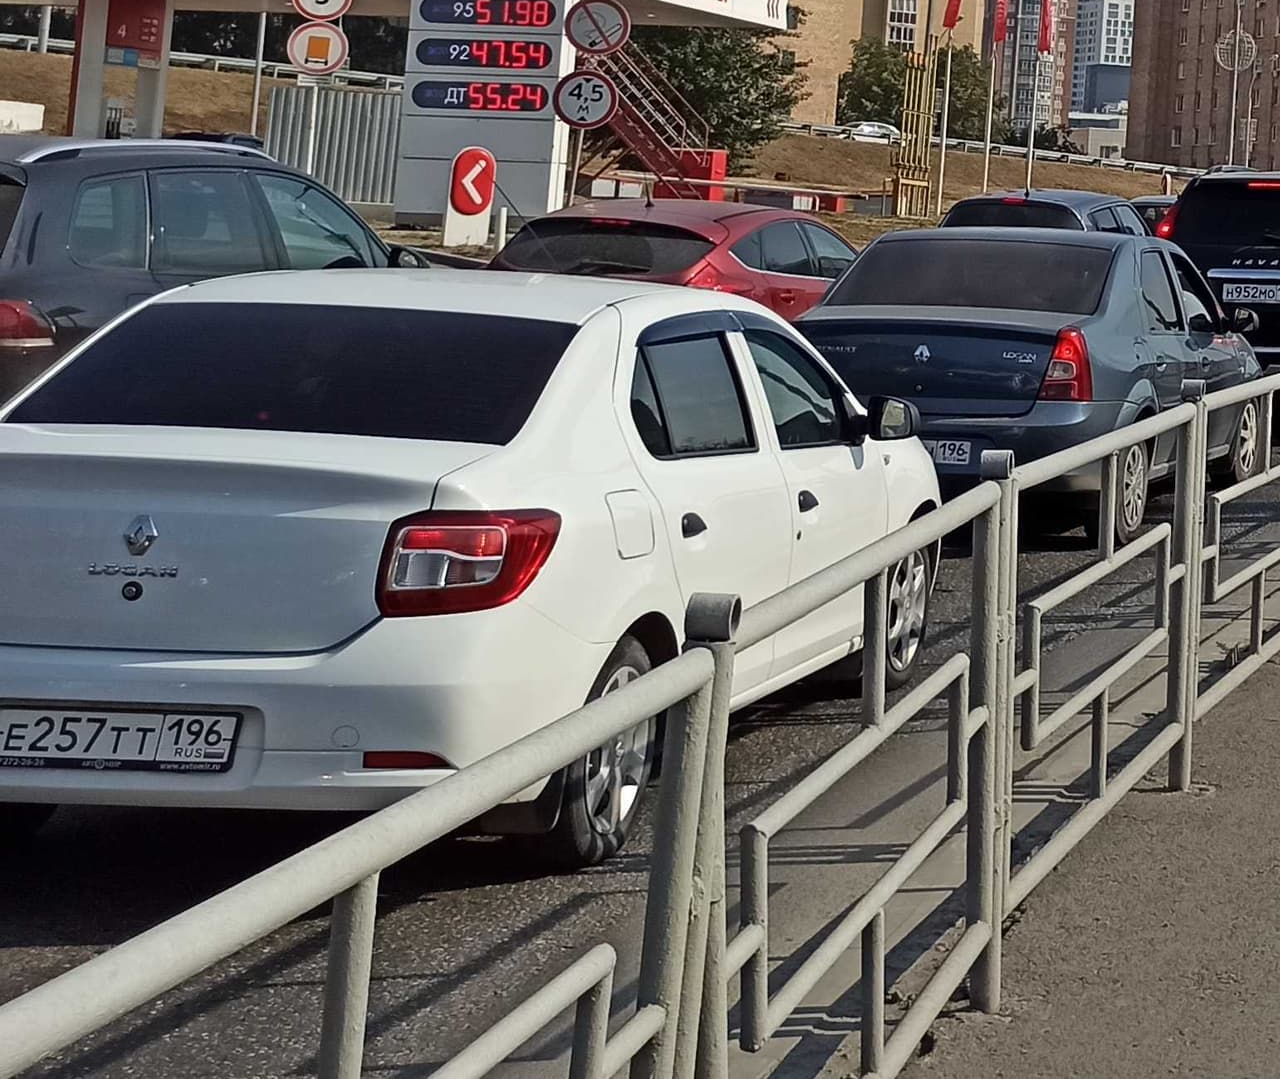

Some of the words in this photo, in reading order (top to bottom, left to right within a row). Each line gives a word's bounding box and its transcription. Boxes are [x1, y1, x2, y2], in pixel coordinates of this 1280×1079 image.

[453, 2, 474, 18] 95
[117, 24, 127, 38] 4
[449, 44, 470, 61] 92
[472, 41, 545, 67] 47.54
[444, 87, 467, 104] ДТ
[468, 83, 542, 110] 55.24
[568, 82, 604, 105] 4,5
[1226, 285, 1276, 299] Н952МО
[1002, 351, 1037, 361] LOGAN
[939, 442, 966, 457] 196
[88, 561, 178, 578] LOGAN
[167, 718, 223, 747] 196
[174, 747, 202, 759] RUS
